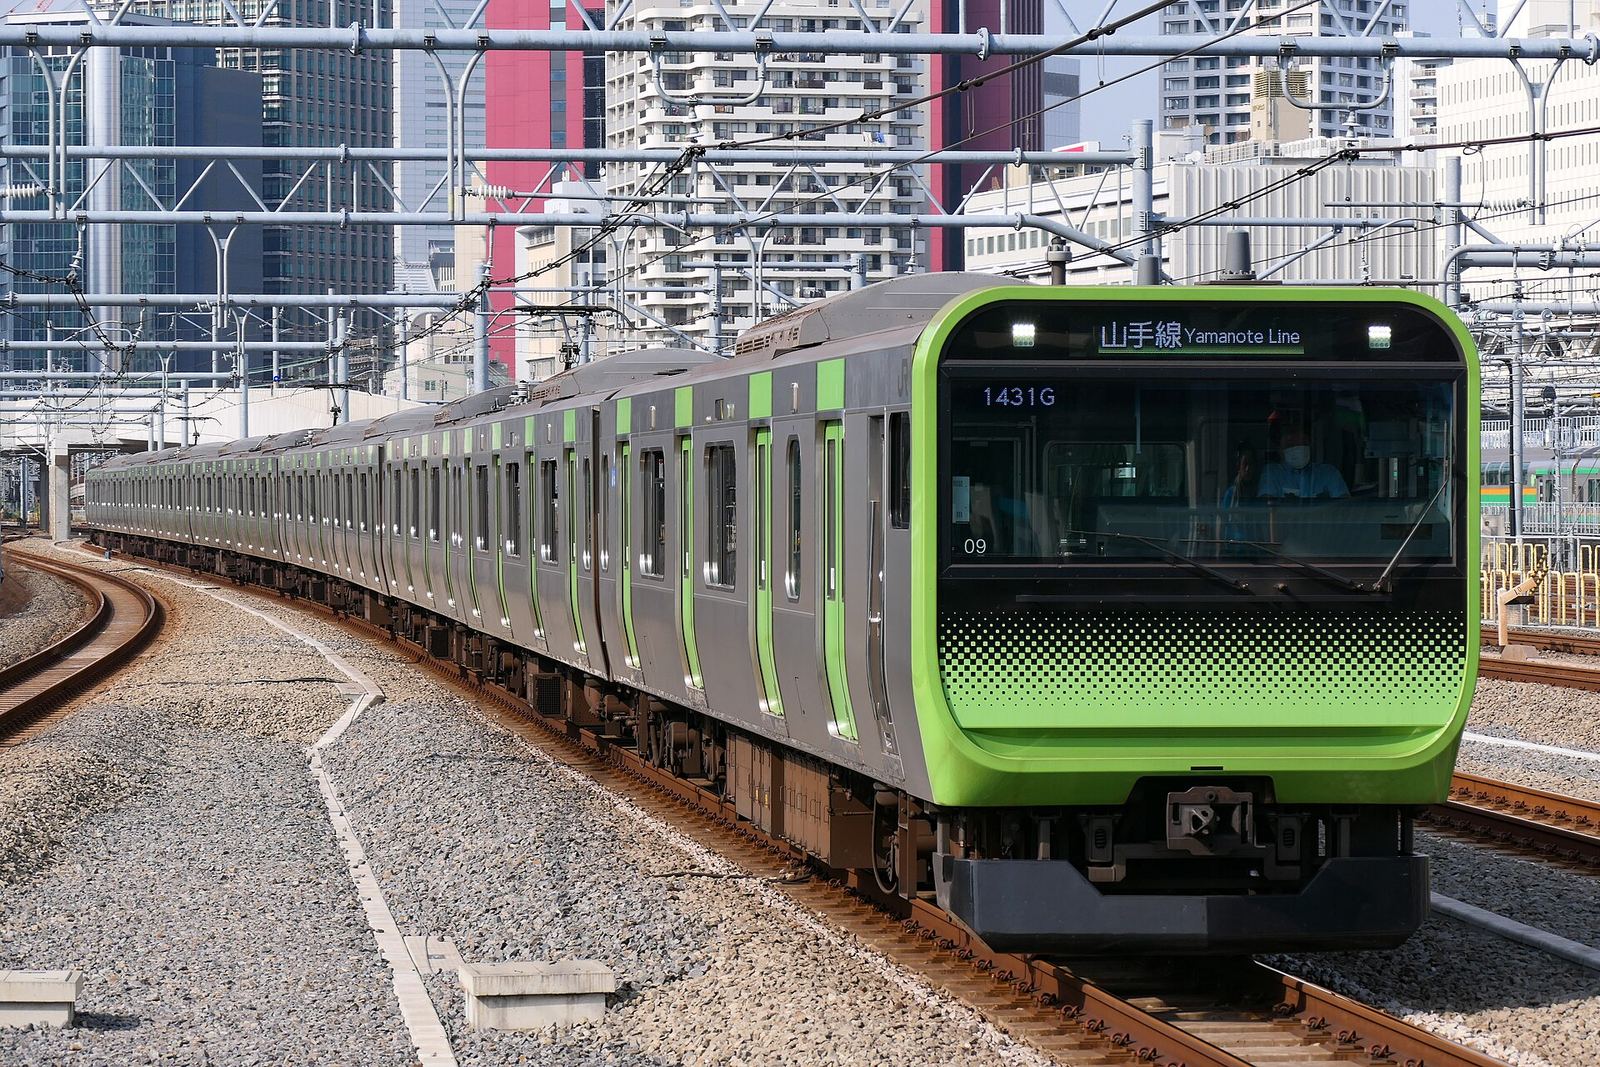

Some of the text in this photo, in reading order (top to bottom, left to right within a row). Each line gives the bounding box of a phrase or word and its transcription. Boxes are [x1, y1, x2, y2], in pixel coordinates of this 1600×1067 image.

[1101, 321, 1301, 349] 山手線 Yamanote Line
[983, 386, 1056, 406] 1431G
[964, 538, 987, 554] 09
